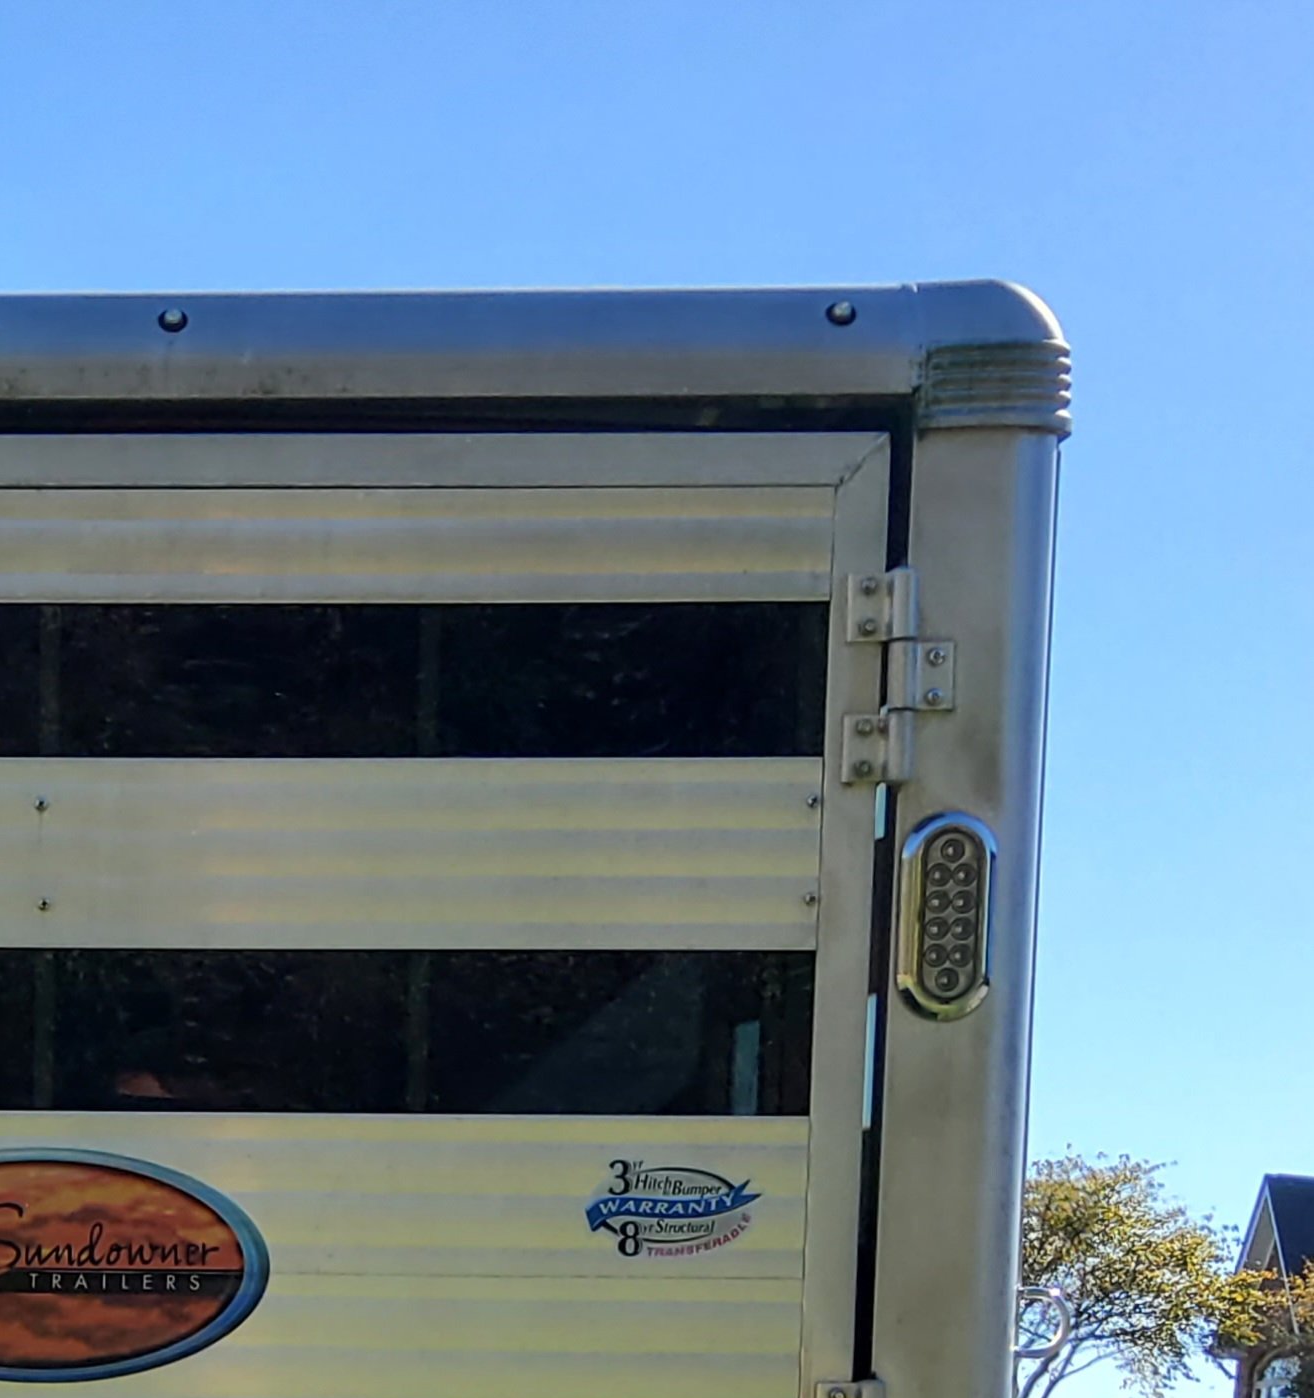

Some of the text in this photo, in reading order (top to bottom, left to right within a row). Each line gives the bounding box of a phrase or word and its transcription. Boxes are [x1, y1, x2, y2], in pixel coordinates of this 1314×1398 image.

[607, 1159, 631, 1196] 3
[633, 1173, 673, 1192] Hitch
[672, 1180, 722, 1198] Bumper
[598, 1190, 736, 1216] WARRANTY
[617, 1220, 641, 1257] 8
[655, 1218, 716, 1235] Structural
[29, 1272, 201, 1291] TRAILERS
